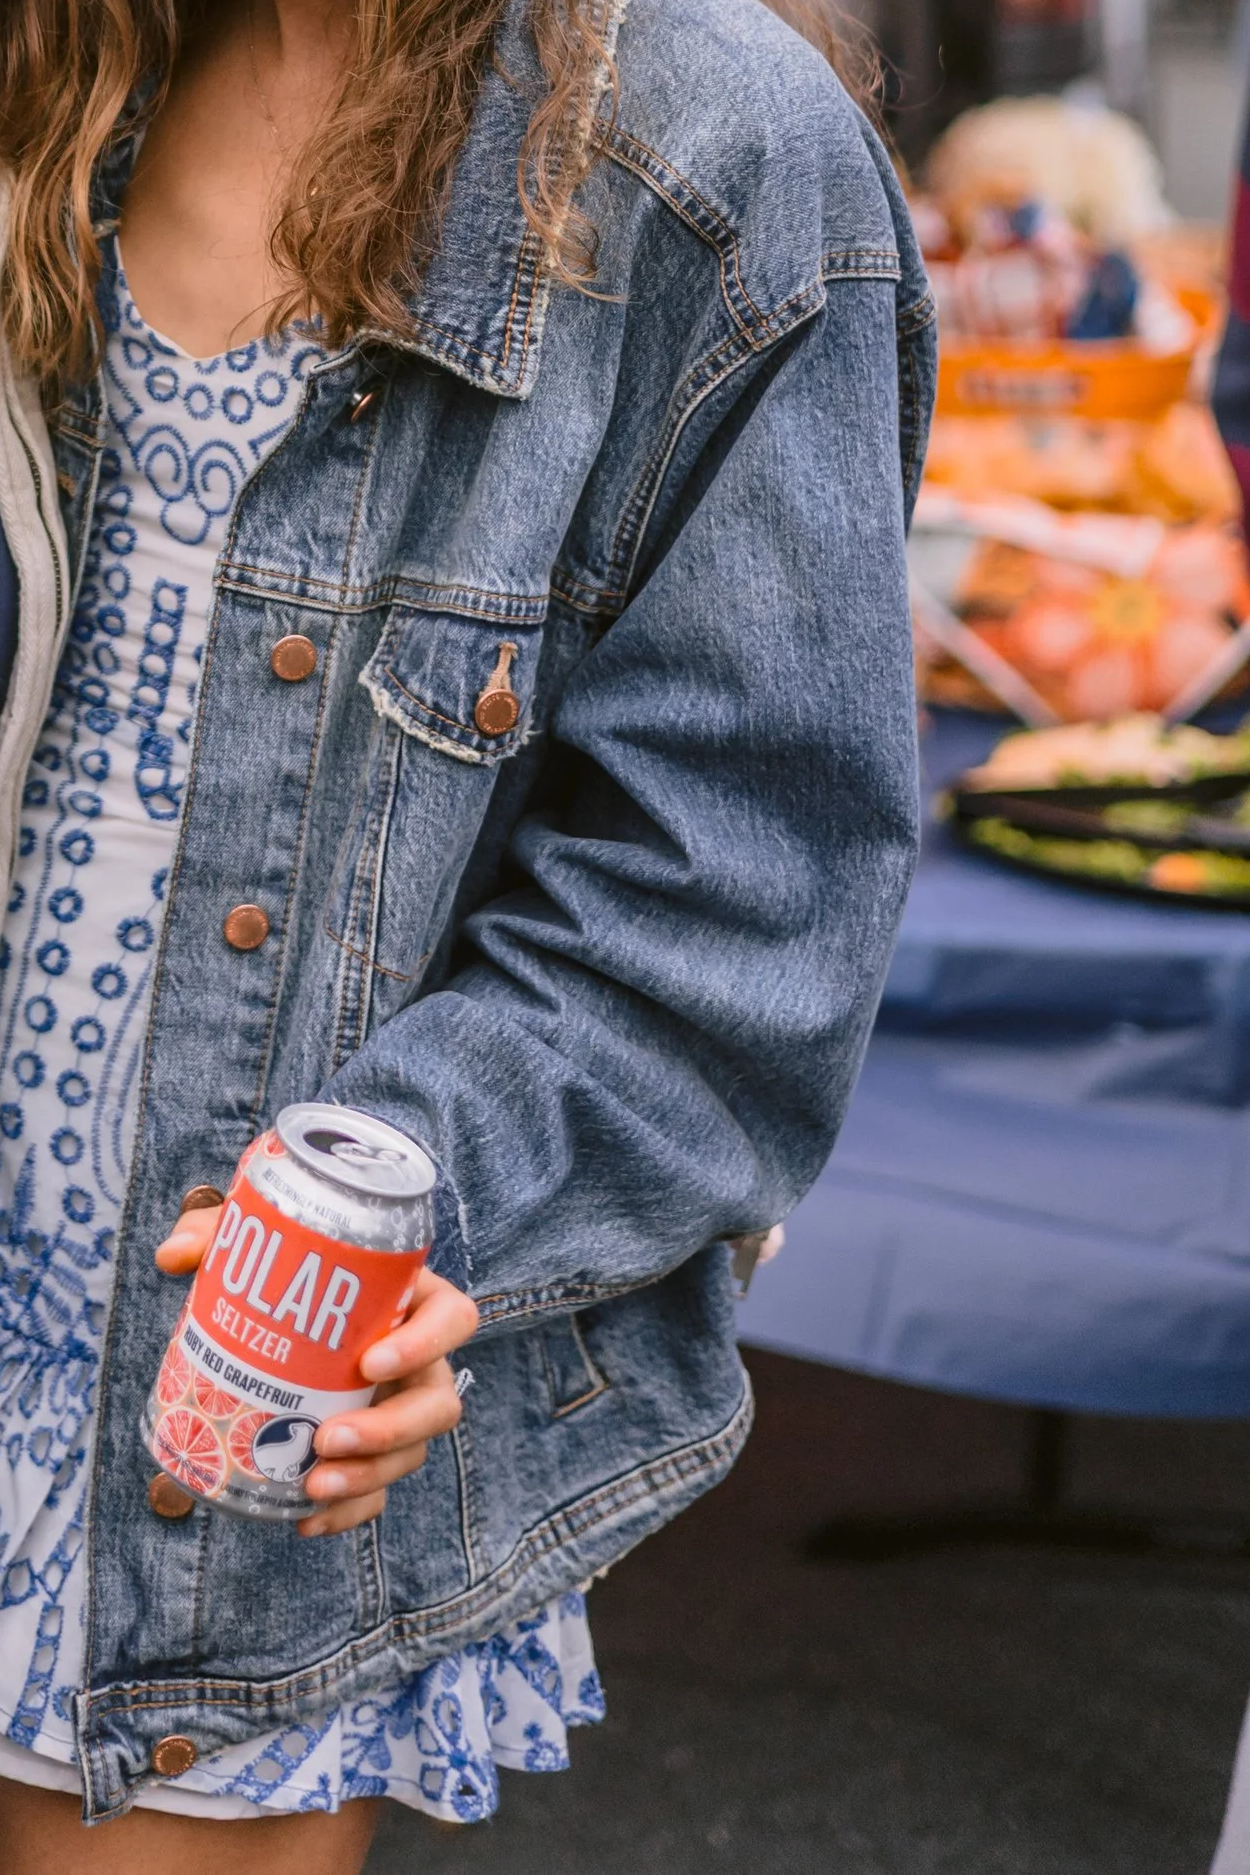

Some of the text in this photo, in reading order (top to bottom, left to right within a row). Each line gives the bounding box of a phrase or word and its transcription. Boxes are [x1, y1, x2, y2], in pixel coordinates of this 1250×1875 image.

[204, 1198, 361, 1351] POLAR
[183, 1325, 304, 1410] RUBY RED GRAPEFRUIT
[211, 1296, 292, 1364] SELTZER
